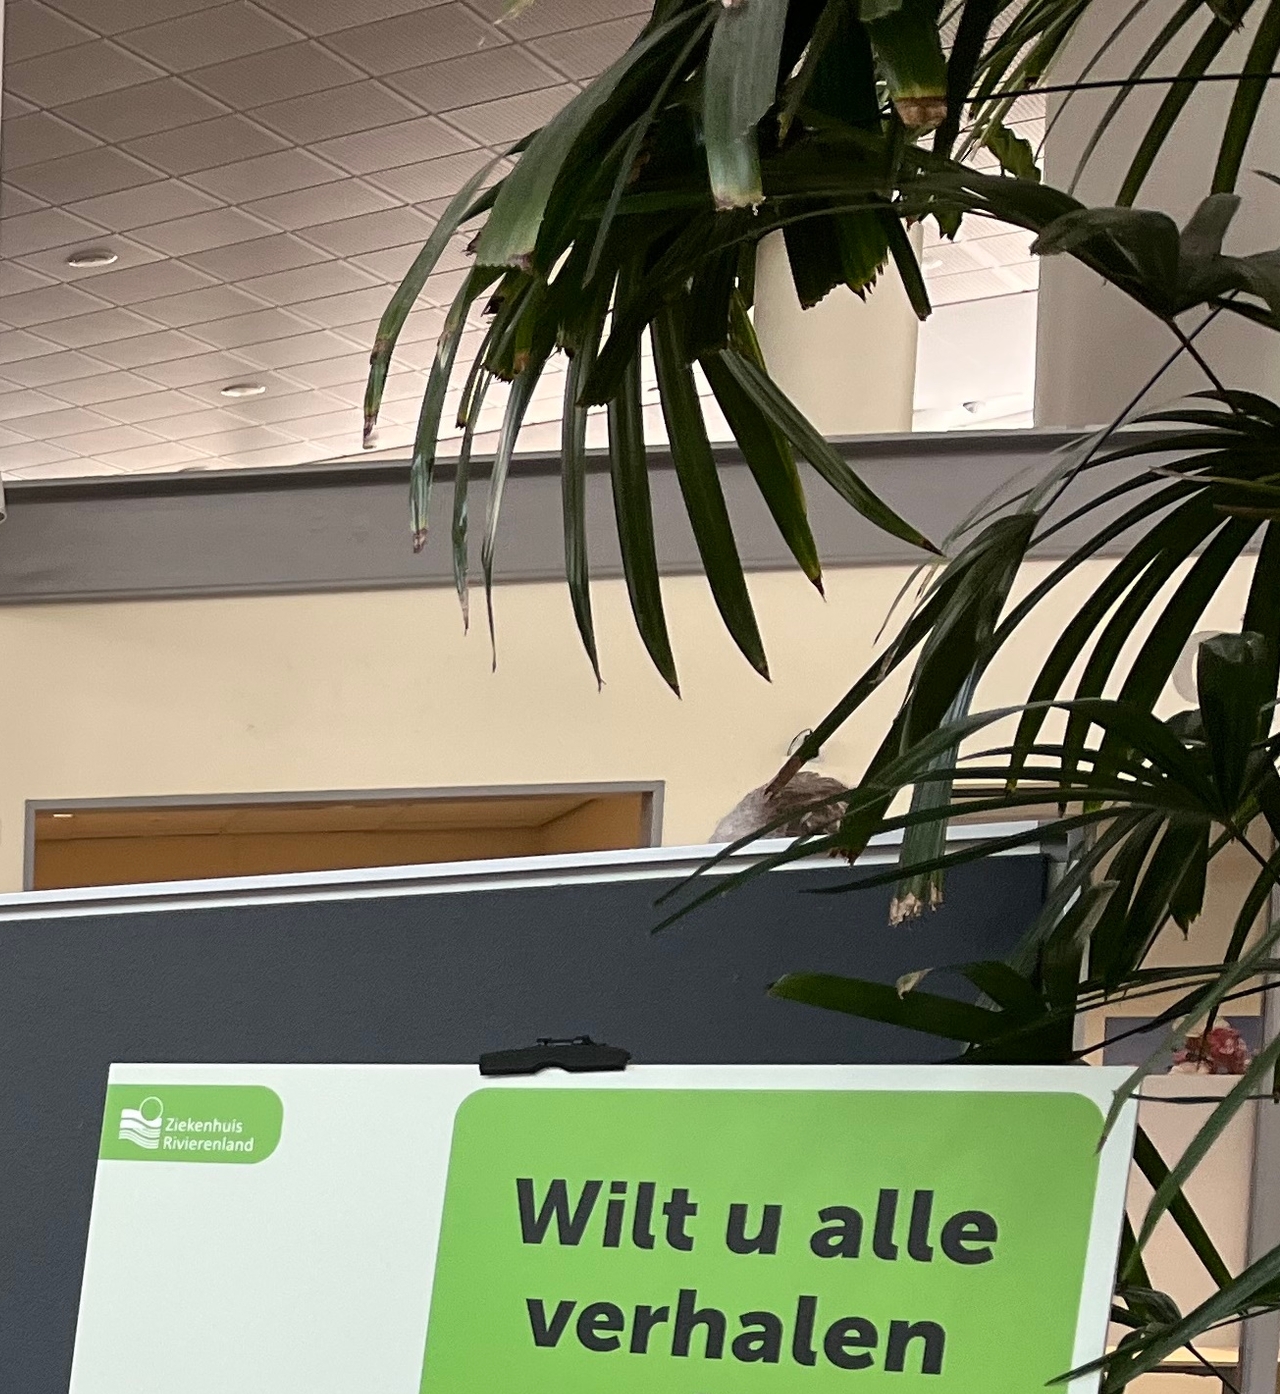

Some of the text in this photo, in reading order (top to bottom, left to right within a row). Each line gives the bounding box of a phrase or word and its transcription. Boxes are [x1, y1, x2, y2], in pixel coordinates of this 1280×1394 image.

[163, 1136, 254, 1152] Rivierenland
[165, 1118, 243, 1134] Ziekenhuis
[516, 1178, 999, 1266] Wilt u alle
[526, 1289, 946, 1376] verhalen
